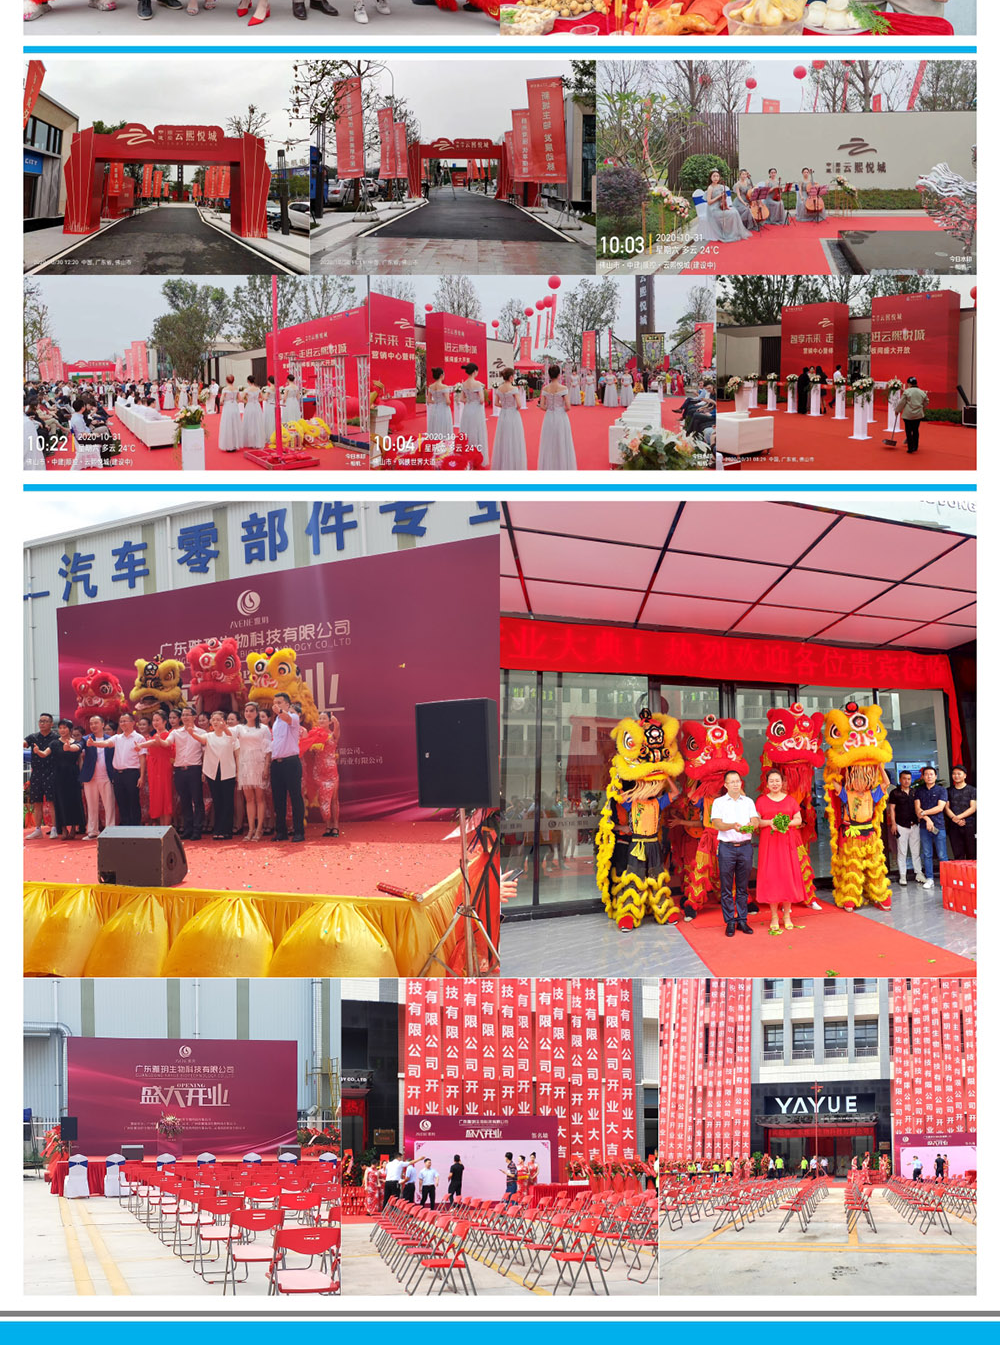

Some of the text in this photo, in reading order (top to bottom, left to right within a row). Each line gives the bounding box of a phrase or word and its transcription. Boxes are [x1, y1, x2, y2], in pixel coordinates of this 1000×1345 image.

[24, 501, 498, 602] 汽车零部件专
[775, 1095, 858, 1114] YAYUE
